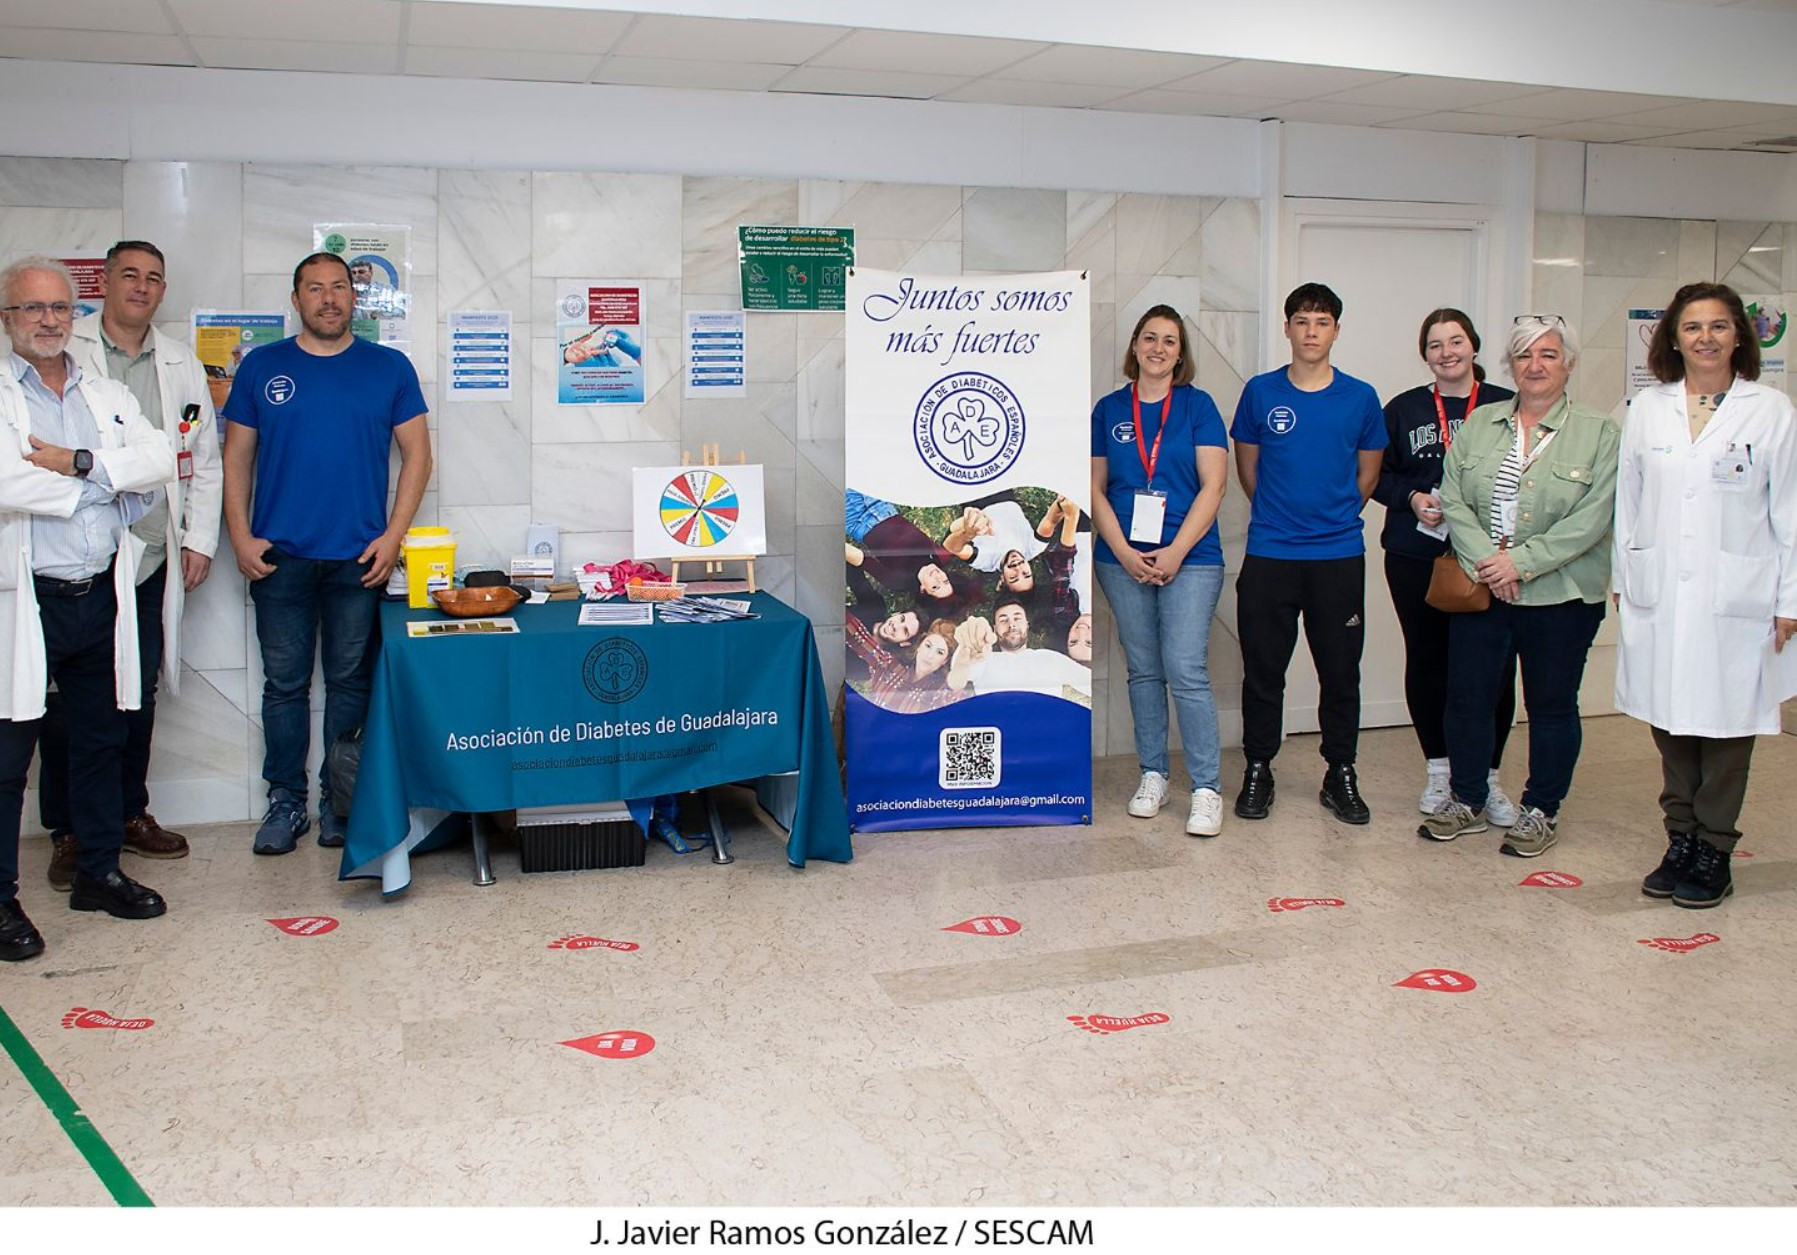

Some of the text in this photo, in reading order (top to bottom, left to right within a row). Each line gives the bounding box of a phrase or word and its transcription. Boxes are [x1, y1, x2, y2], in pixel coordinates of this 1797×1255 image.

[864, 278, 1072, 322] Juntos somos
[885, 321, 1040, 366] más fuertes
[920, 378, 1022, 460] ASOCIACIÓN DE DIABETICOS ESPAÑOLES
[966, 406, 975, 417] D
[950, 422, 960, 433] A
[980, 425, 989, 437] E
[1409, 423, 1437, 455] LOS
[446, 708, 778, 751] Asociación de Diabetes de Guadalajara
[856, 794, 1085, 813] asociaciondiabetesguadalajara@gmail.com
[85, 1014, 120, 1026] HUELLA
[1137, 1015, 1162, 1024] DEJA
